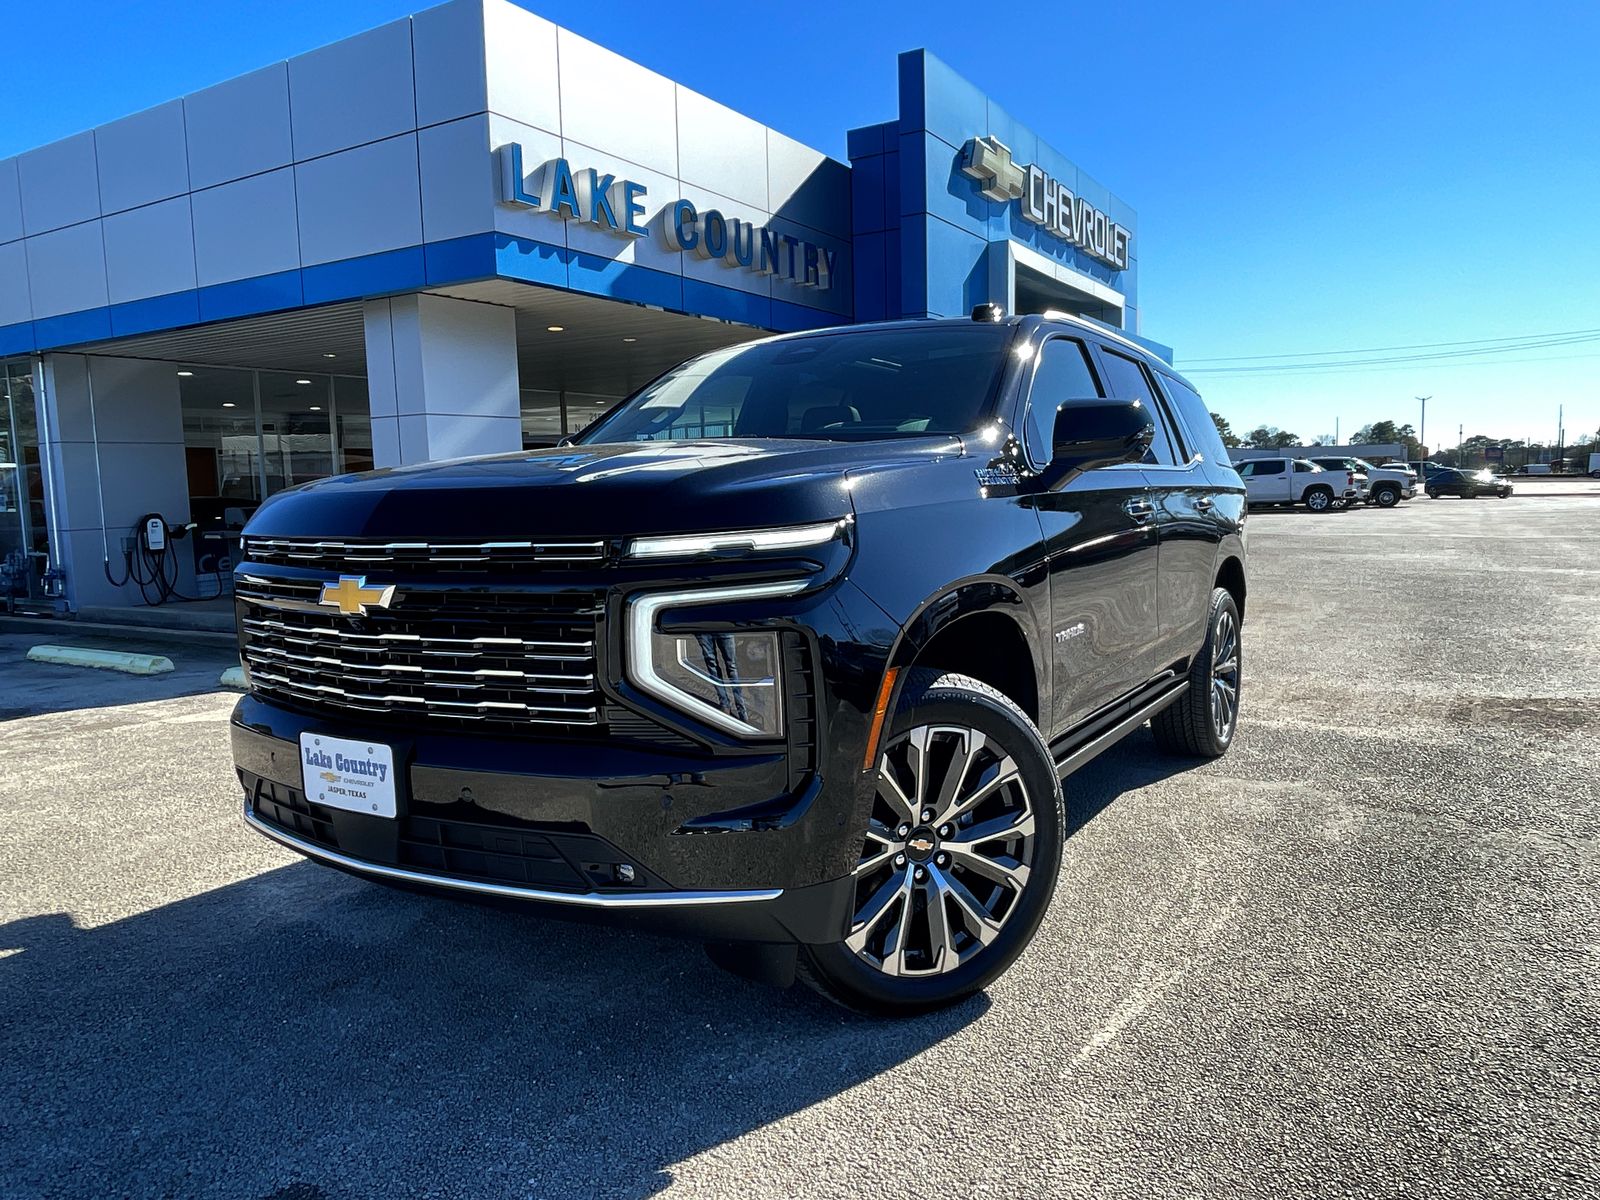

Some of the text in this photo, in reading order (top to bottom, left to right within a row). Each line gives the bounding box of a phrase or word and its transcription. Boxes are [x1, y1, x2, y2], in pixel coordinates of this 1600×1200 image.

[502, 142, 836, 290] LAKE COUNTRY
[1021, 163, 1132, 271] CHEVROLET
[305, 747, 387, 782] Lake Country
[347, 789, 367, 799] TEXAS
